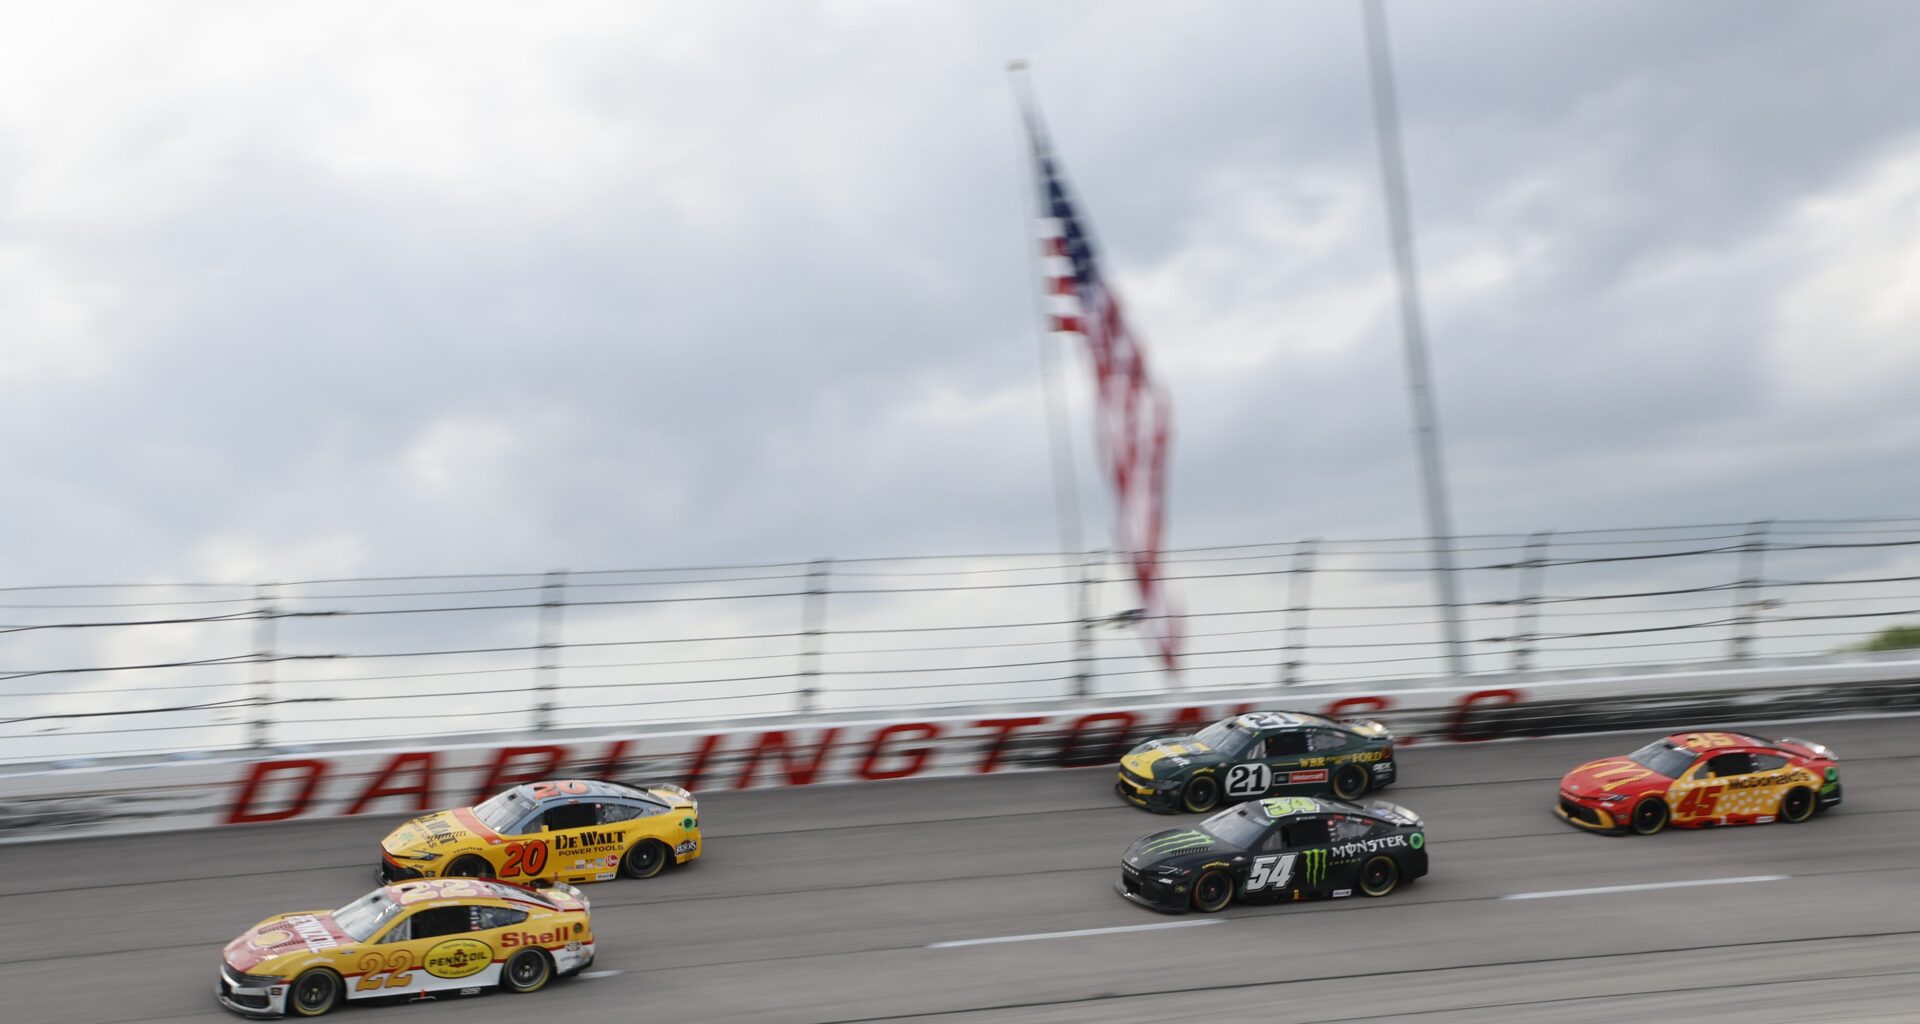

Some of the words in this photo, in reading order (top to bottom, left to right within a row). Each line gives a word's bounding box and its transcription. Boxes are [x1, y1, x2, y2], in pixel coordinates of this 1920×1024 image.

[1229, 764, 1266, 794] 21
[1677, 785, 1724, 818] 45
[499, 839, 549, 878] 20
[558, 848, 592, 857] POWER
[594, 844, 625, 854] TOOLS
[1331, 834, 1408, 859] MONSTER
[1246, 852, 1298, 893] 54
[391, 878, 477, 905] 22
[501, 926, 569, 948] Shell
[354, 948, 416, 993] 22
[429, 951, 488, 968] PENNZOIL
